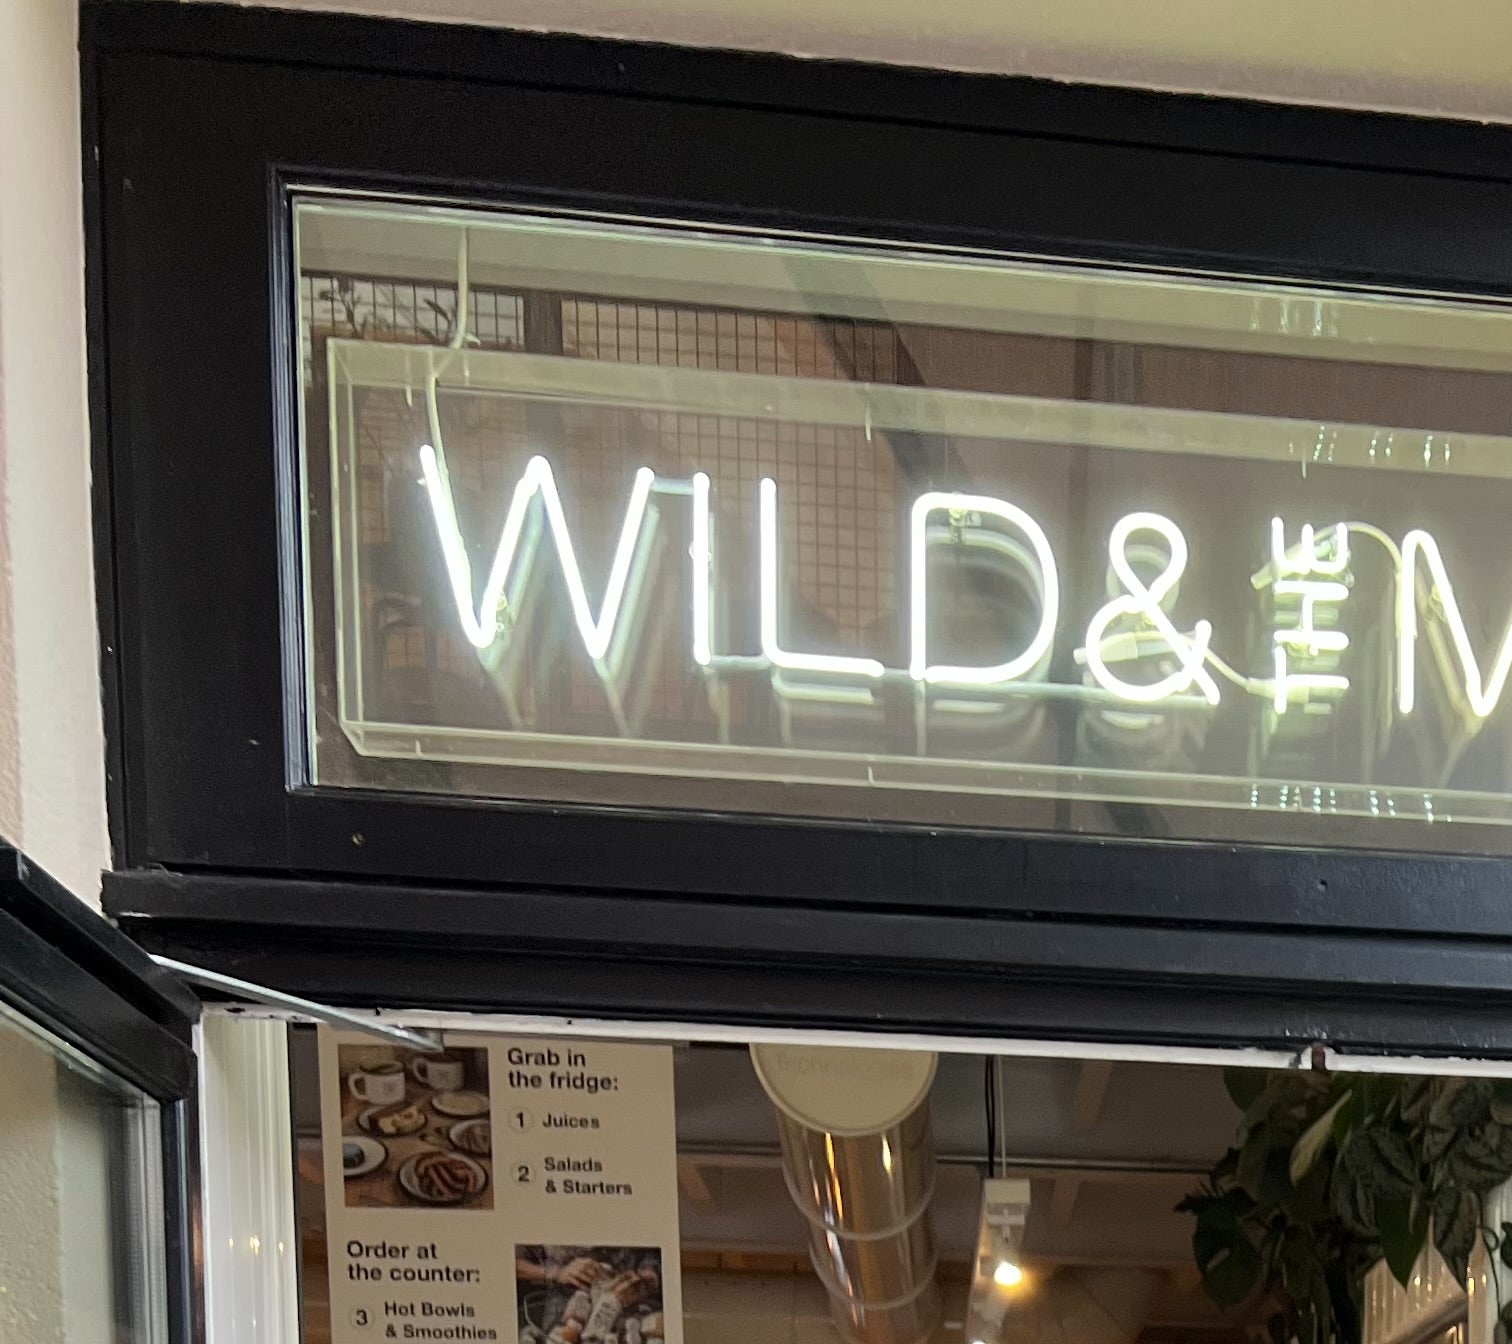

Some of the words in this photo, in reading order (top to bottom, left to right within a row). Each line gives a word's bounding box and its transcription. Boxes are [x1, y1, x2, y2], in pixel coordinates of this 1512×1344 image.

[419, 445, 1059, 682] WILD
[1085, 512, 1221, 705] &
[1270, 516, 1350, 716] THE
[507, 1047, 560, 1066] Grab
[568, 1049, 586, 1067] in
[508, 1071, 542, 1089] the
[550, 1071, 619, 1094] fridge:
[515, 1111, 525, 1129] 1
[542, 1112, 600, 1129] Juices
[544, 1156, 603, 1172] Salads
[517, 1165, 530, 1183] 2
[545, 1179, 557, 1194] &
[563, 1179, 633, 1195] Starters
[346, 1240, 411, 1259] Order
[416, 1243, 438, 1260] at
[347, 1263, 382, 1281] the
[390, 1265, 480, 1283] counter:
[355, 1309, 369, 1326] 3
[384, 1301, 417, 1317] Hot
[421, 1301, 475, 1318] Bowls
[385, 1323, 398, 1339] &
[403, 1324, 498, 1341] Smoothies
